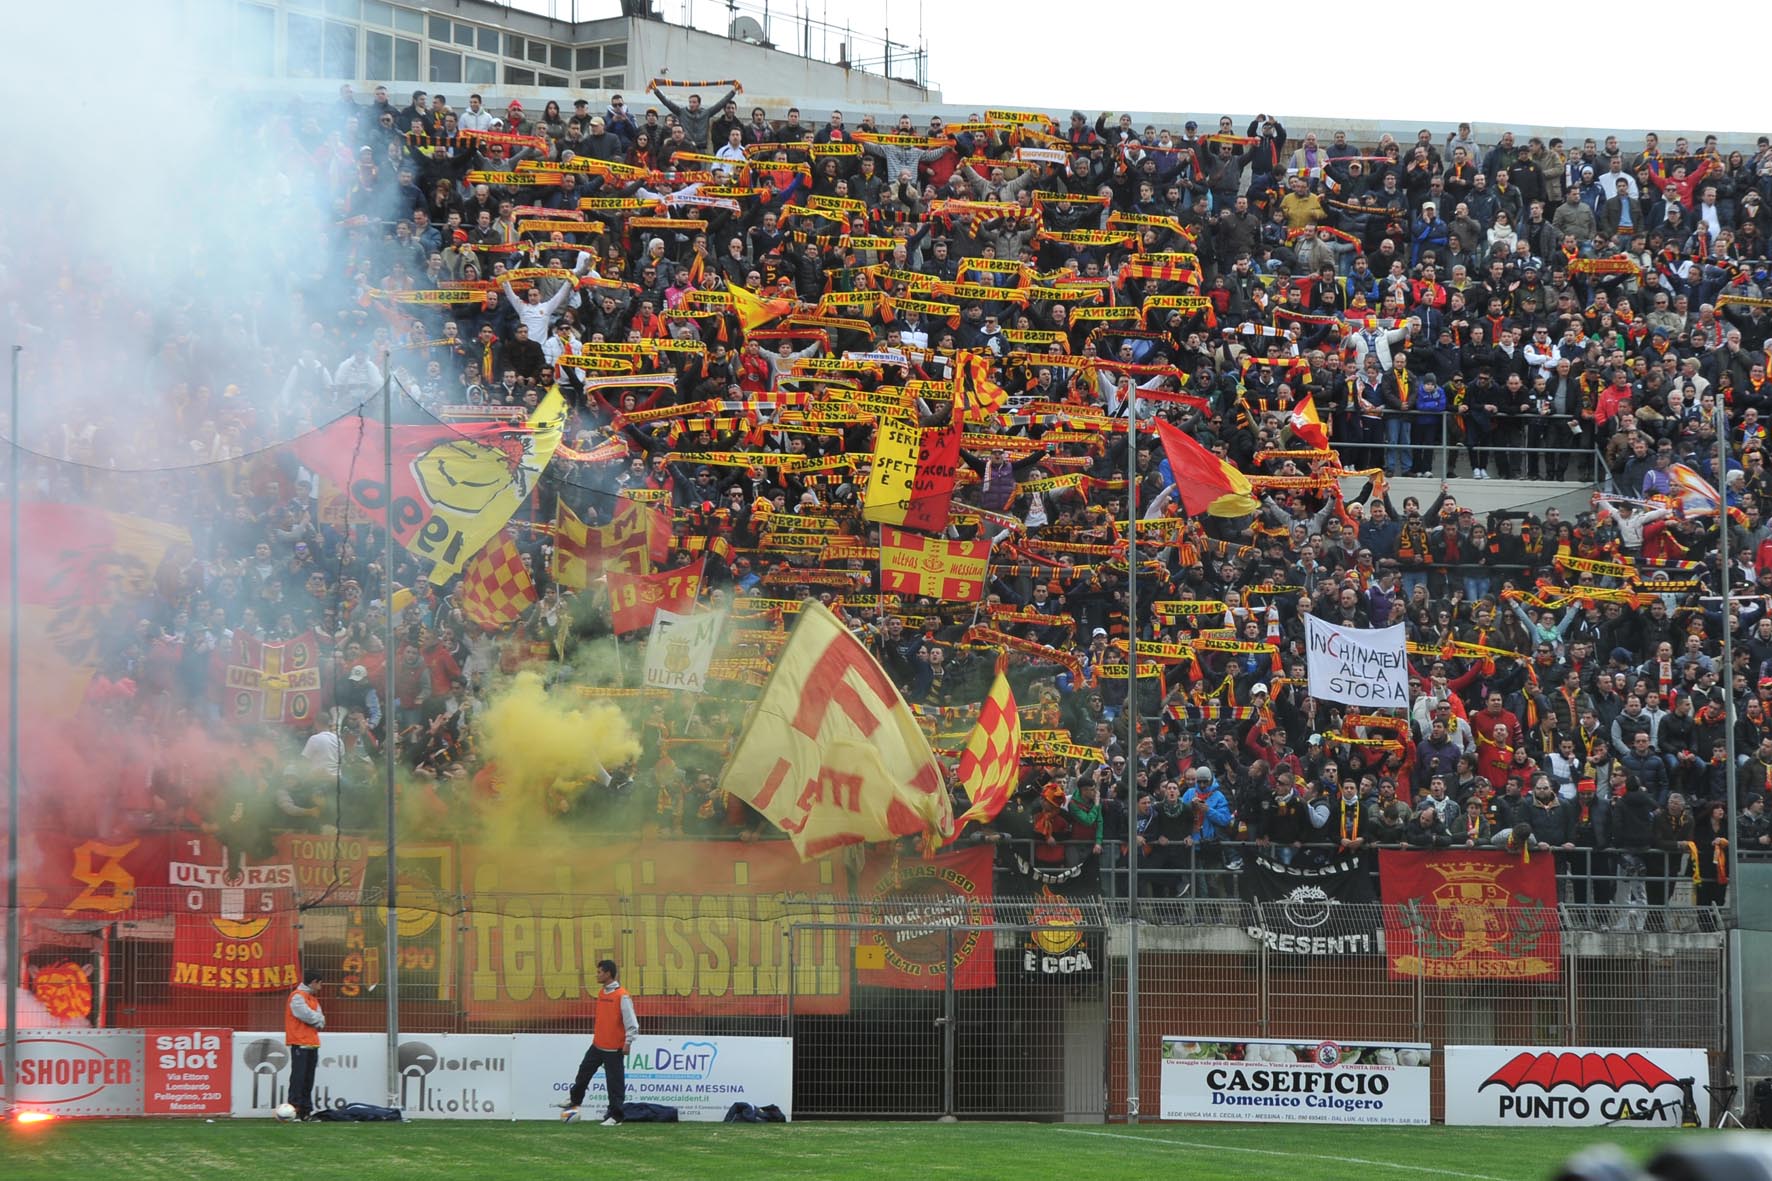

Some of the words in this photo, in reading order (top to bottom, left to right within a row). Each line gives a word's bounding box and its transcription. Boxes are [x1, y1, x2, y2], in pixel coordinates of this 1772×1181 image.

[852, 238, 896, 248] ESSINA
[889, 431, 926, 447] SERIE
[936, 437, 945, 448] A
[909, 449, 930, 460] LO
[877, 457, 955, 478] SPETTACOLO
[904, 480, 934, 491] QUA
[750, 601, 800, 612] MESSIN
[1103, 664, 1161, 675] MESINA
[1340, 662, 1388, 683] ALLA
[1329, 678, 1407, 702] STORIA
[1051, 743, 1094, 758] SSINA
[1248, 925, 1369, 955] PRESENTI
[173, 961, 299, 989] MESSINA
[156, 1031, 221, 1050] sala
[159, 1050, 218, 1069] slot
[640, 1083, 683, 1093] DOMANI
[685, 1084, 693, 1093] A
[695, 1084, 745, 1094] MESSINA
[1206, 1069, 1389, 1095] CASEIFICIO
[639, 1094, 710, 1102] www.socialdent.it
[1212, 1091, 1301, 1108] Domenico
[1305, 1094, 1384, 1112] Calogero
[1499, 1095, 1590, 1120] PUNTO
